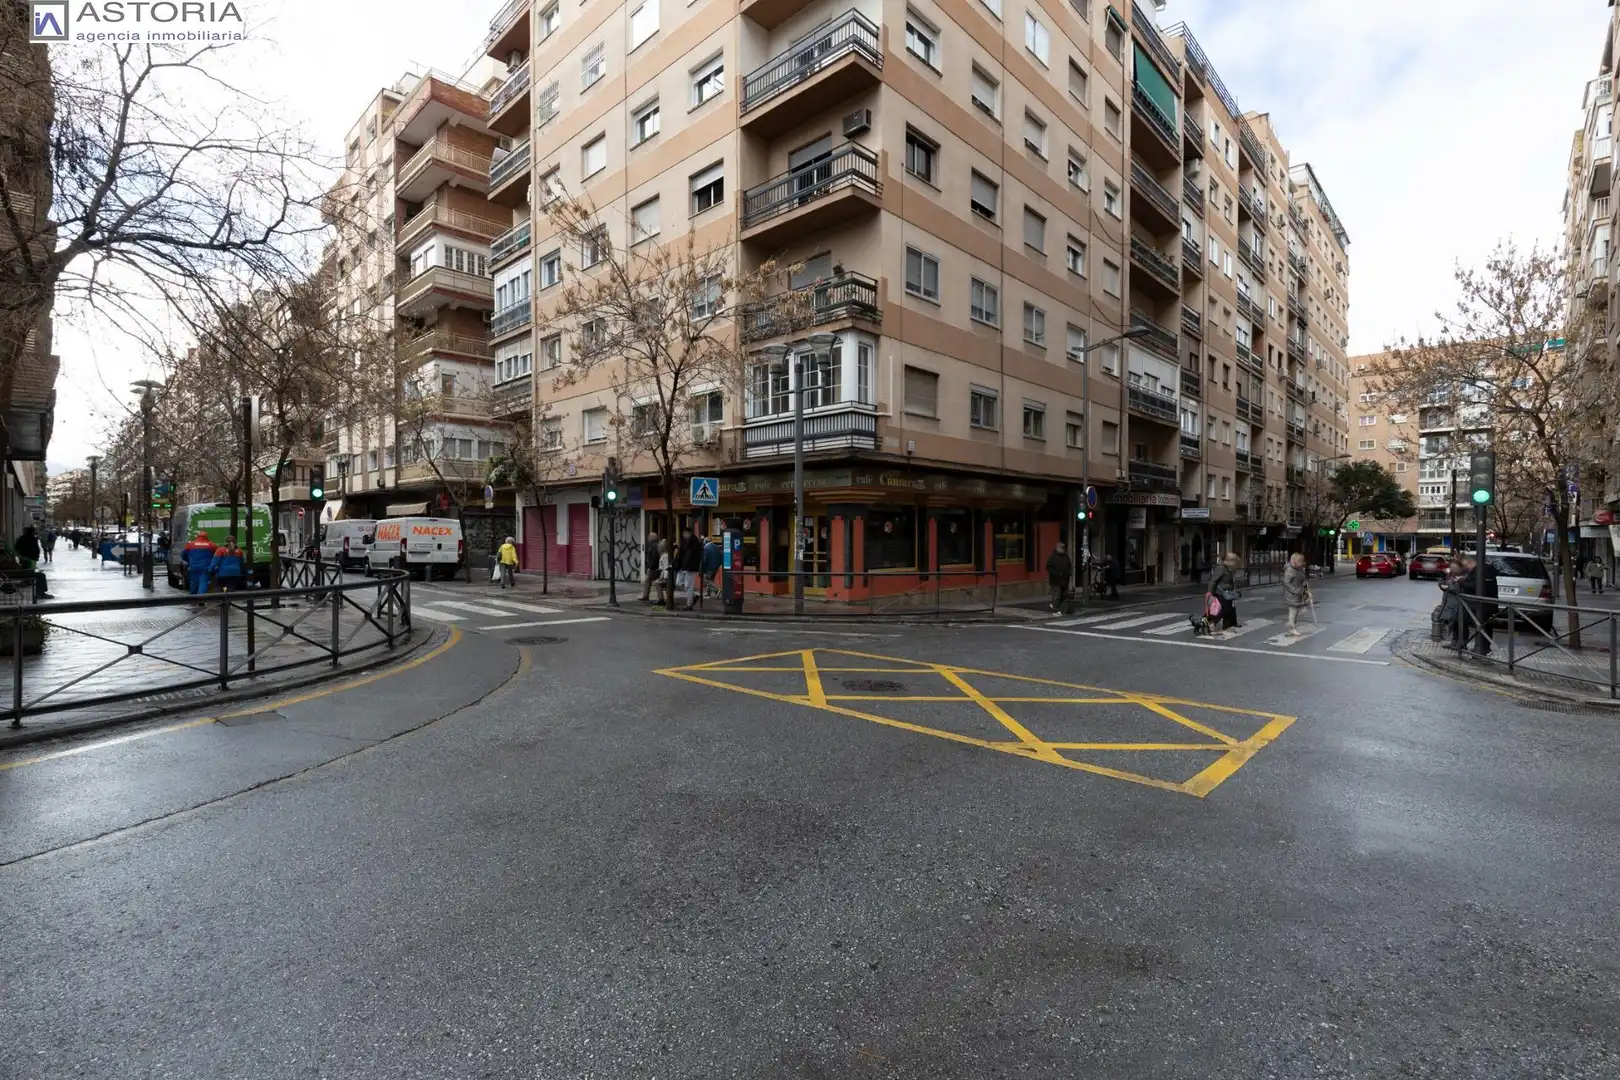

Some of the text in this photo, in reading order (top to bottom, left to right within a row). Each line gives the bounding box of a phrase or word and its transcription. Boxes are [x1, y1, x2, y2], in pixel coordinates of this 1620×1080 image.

[236, 519, 264, 528] SEUR
[412, 525, 453, 536] NACEX
[733, 539, 741, 550] P
